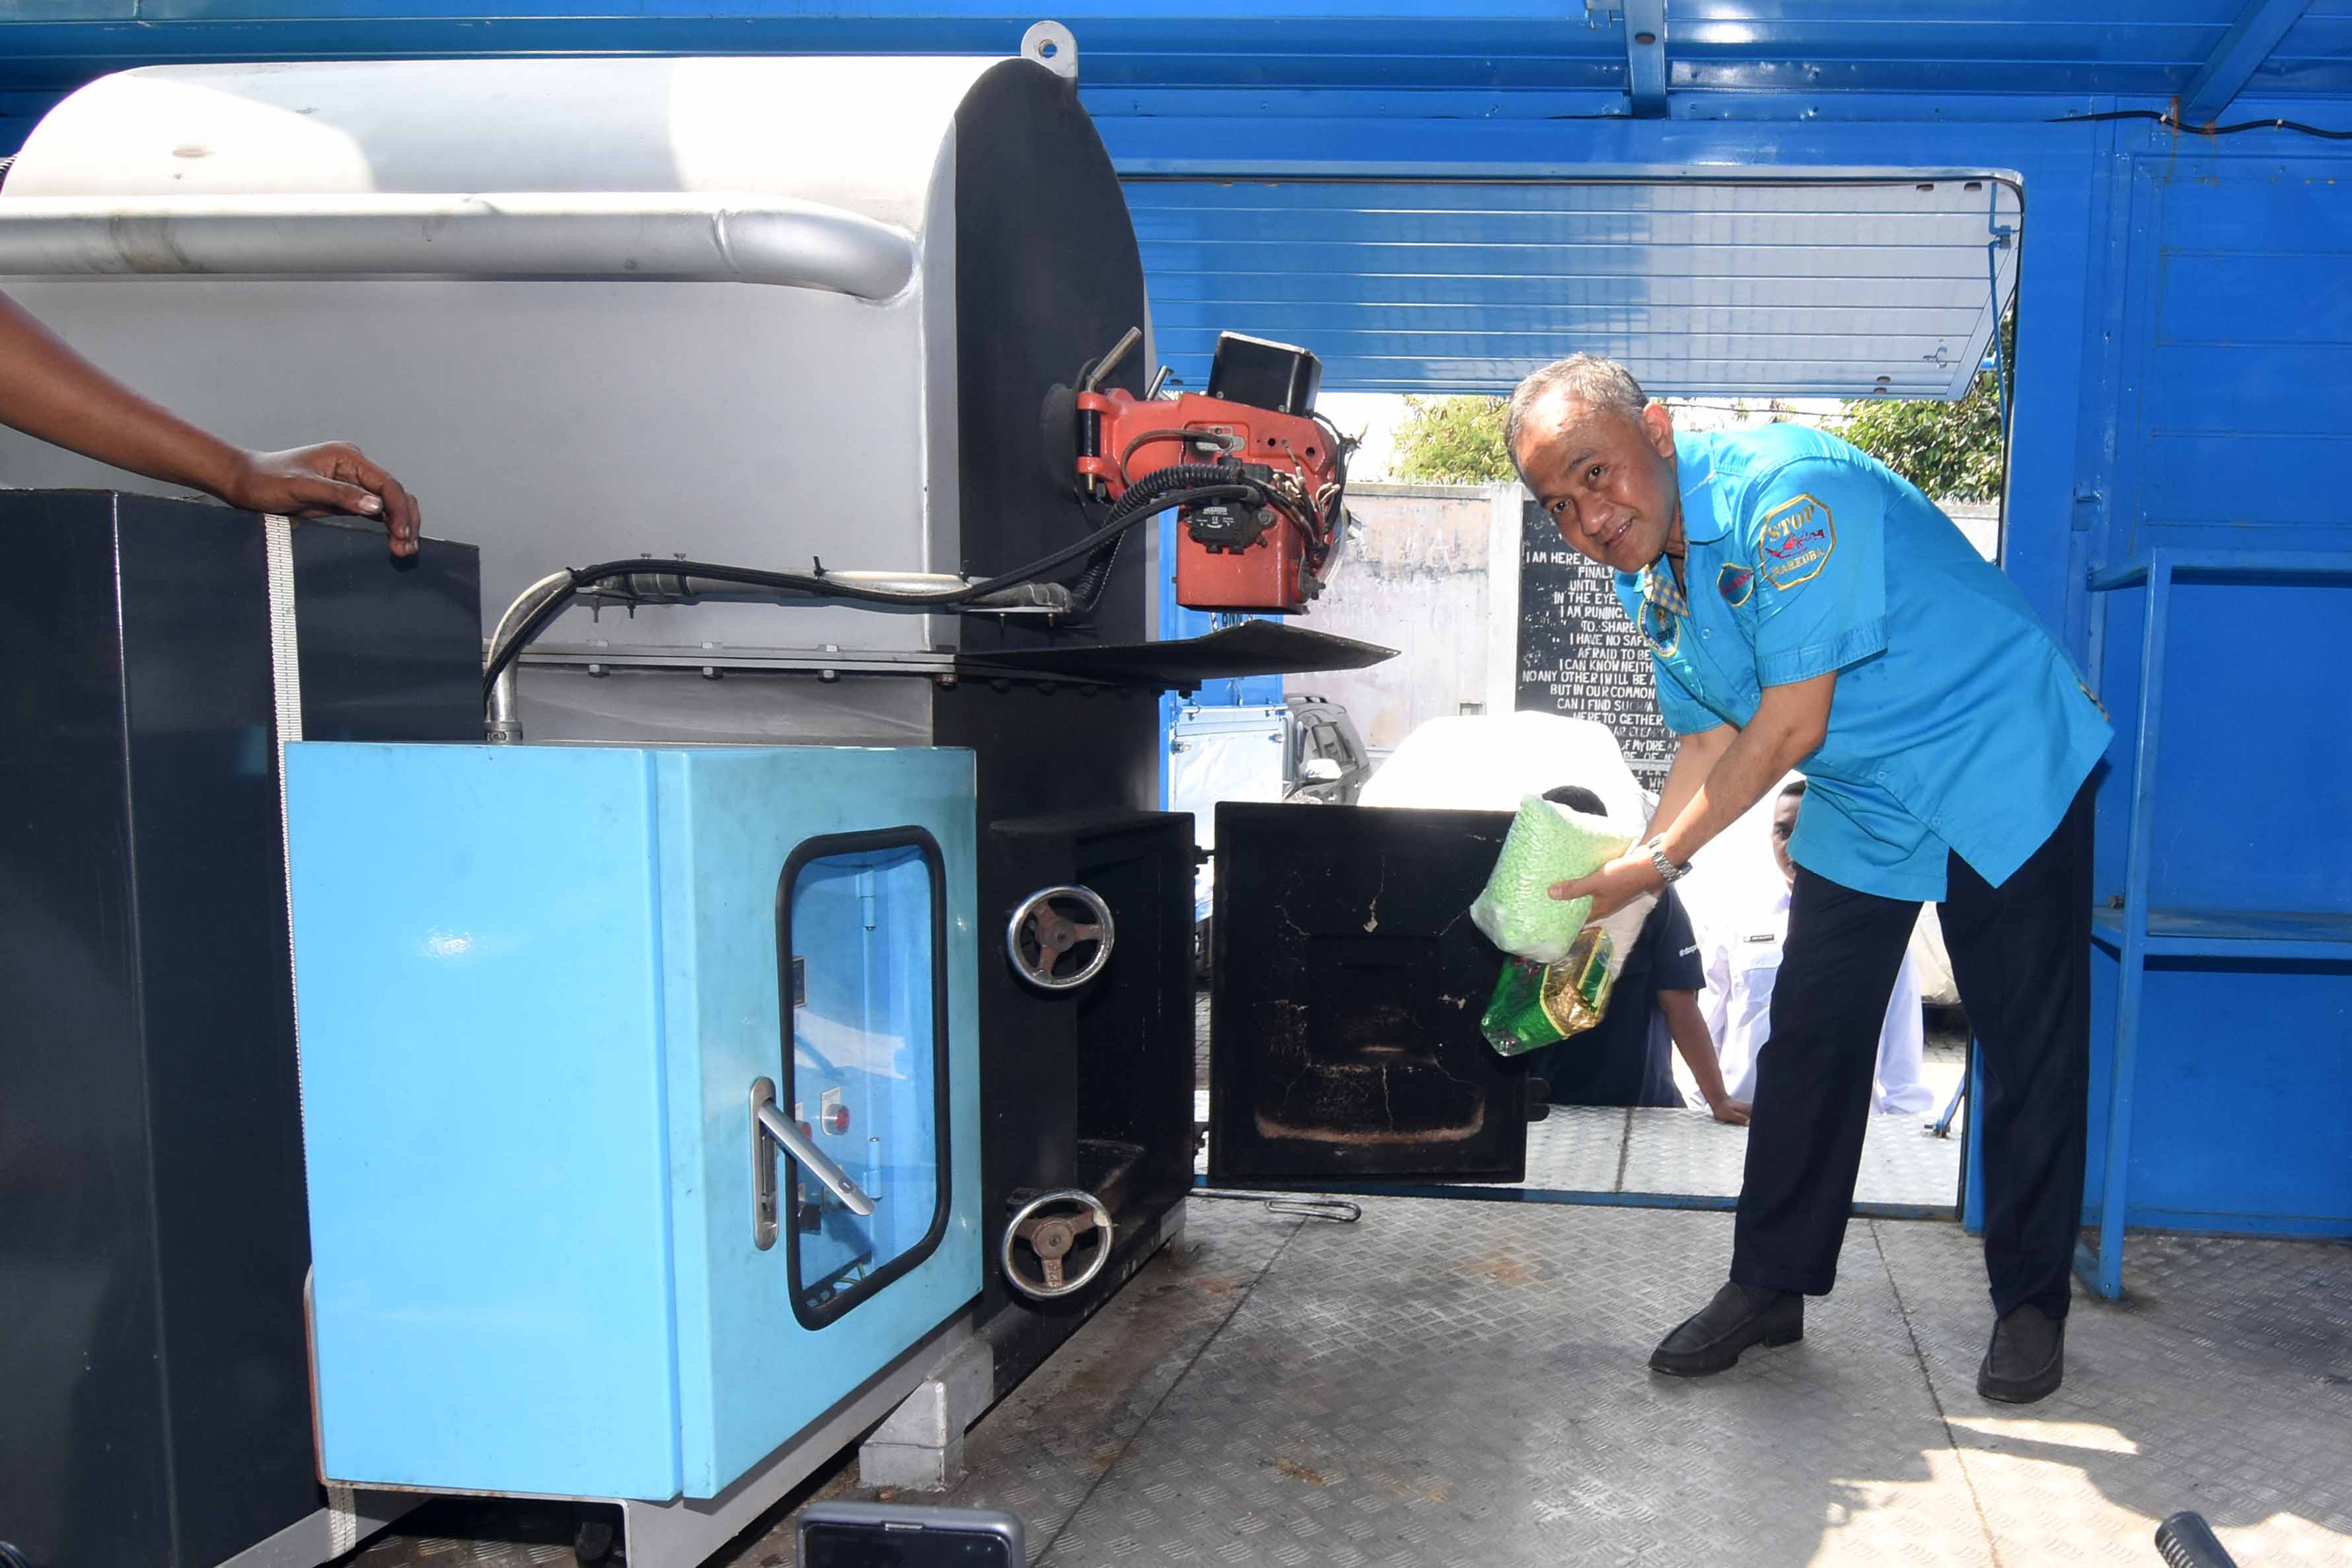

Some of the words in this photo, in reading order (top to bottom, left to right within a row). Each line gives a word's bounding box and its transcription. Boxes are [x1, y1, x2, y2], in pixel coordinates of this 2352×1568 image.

[1768, 505, 1815, 542] STOP
[1526, 552, 1530, 563] I
[1532, 552, 1547, 563] AM
[1551, 552, 1581, 565] HERE
[1578, 566, 1615, 579] FINALY
[1569, 580, 1599, 592] UNTIL
[1554, 592, 1564, 605] IN
[1568, 592, 1591, 604] THE
[1595, 593, 1623, 606] EYE
[1567, 606, 1582, 618] AM
[1585, 606, 1623, 620] RUNING
[1601, 621, 1637, 633] SHARE
[1576, 633, 1603, 646] HAVE
[1605, 634, 1621, 647] NO
[1578, 647, 1617, 661] AFRAID
[1621, 649, 1635, 660] TO
[1637, 649, 1652, 661] BE
[1564, 659, 1586, 672] CAN
[1589, 660, 1619, 672] KNOW
[1621, 661, 1655, 673] NEITH
[1522, 670, 1537, 682] NO
[1537, 670, 1558, 683] ANY
[1561, 670, 1597, 684] OTHER
[1605, 674, 1629, 685] WILL
[1633, 674, 1647, 685] BE
[1550, 684, 1572, 695] BUT
[1573, 684, 1584, 696] IN
[1586, 686, 1609, 697] OUR
[1610, 686, 1656, 699] COMMON
[1557, 698, 1578, 709] CAN
[1588, 699, 1611, 711] FIND
[1573, 711, 1601, 722] HERE
[1602, 712, 1616, 725] TO
[1619, 713, 1664, 726] GETHER
[1633, 739, 1645, 752] MY
